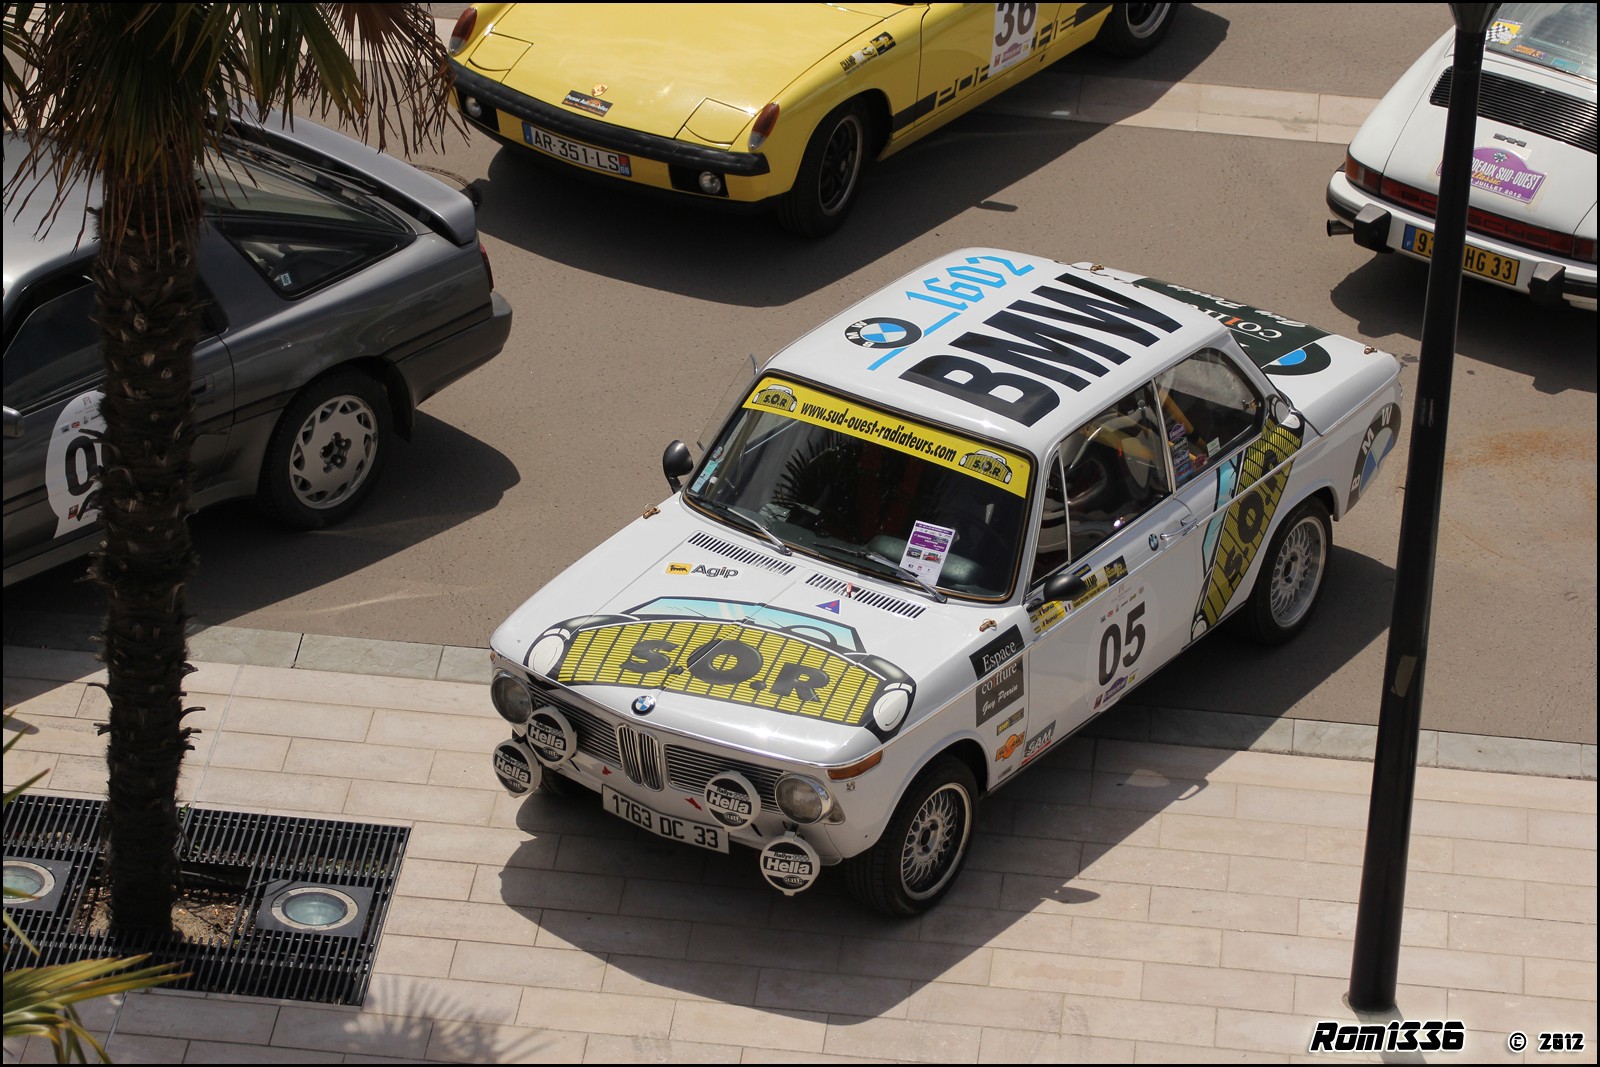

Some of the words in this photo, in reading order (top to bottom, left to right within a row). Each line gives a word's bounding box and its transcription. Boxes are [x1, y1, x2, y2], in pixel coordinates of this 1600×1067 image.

[995, 3, 1037, 47] 36
[534, 130, 619, 172] AR-351-LS
[906, 255, 1036, 310] 1602
[1464, 247, 1486, 272] HG
[1490, 256, 1513, 281] 33
[898, 272, 1184, 428] BMW
[800, 402, 958, 463] www.sud-ouest-radiateurs.com
[690, 564, 739, 579] Agip
[982, 641, 1017, 674] Espace
[1098, 601, 1146, 686] 05
[530, 726, 565, 750] Hella
[496, 757, 529, 783] Hella
[612, 794, 652, 829] 1763
[659, 816, 685, 840] DC
[693, 825, 719, 848] 33
[709, 792, 750, 814] Hella
[766, 858, 810, 874] Hella
